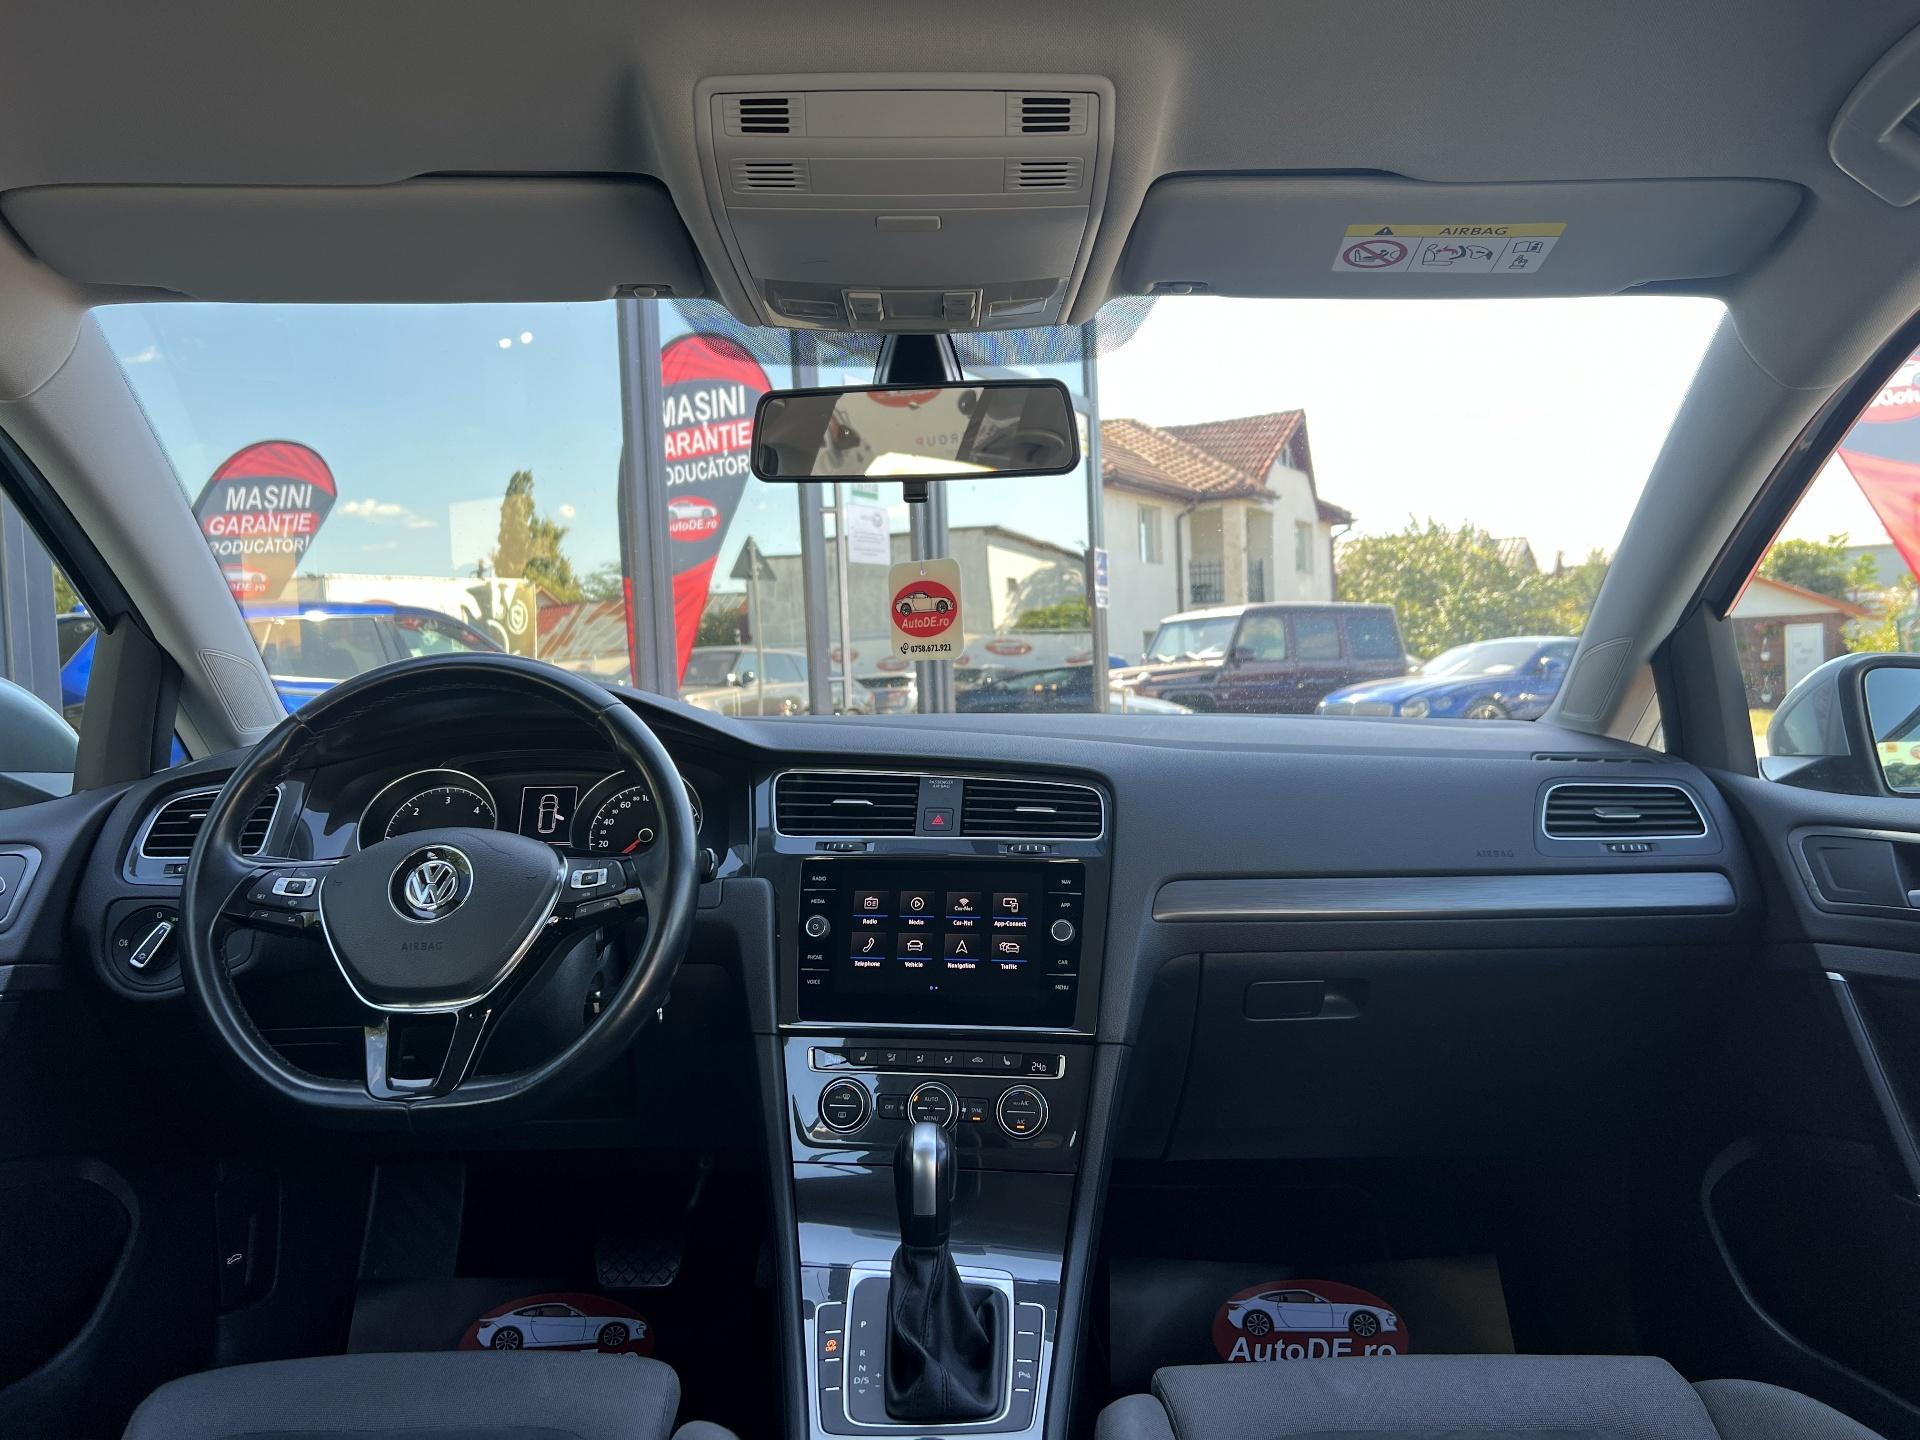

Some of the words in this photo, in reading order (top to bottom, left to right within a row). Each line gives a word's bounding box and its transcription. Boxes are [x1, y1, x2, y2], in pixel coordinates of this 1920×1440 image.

[1439, 226, 1509, 236] AIRBAG
[664, 421, 752, 459] ARANȚIE
[901, 615, 950, 629] AutoDE.ro
[910, 643, 951, 653] 0758.671.921
[445, 796, 451, 804] 3
[413, 807, 419, 815] 2
[473, 806, 480, 814] 4
[993, 920, 1027, 928] App-Connect
[854, 960, 881, 968] Telephone
[947, 962, 976, 970] Navigation
[860, 1320, 867, 1328] P
[859, 1349, 866, 1357] R
[1227, 1336, 1397, 1362] AutoDEro
[858, 1364, 867, 1372] N
[853, 1376, 870, 1385] D/S
